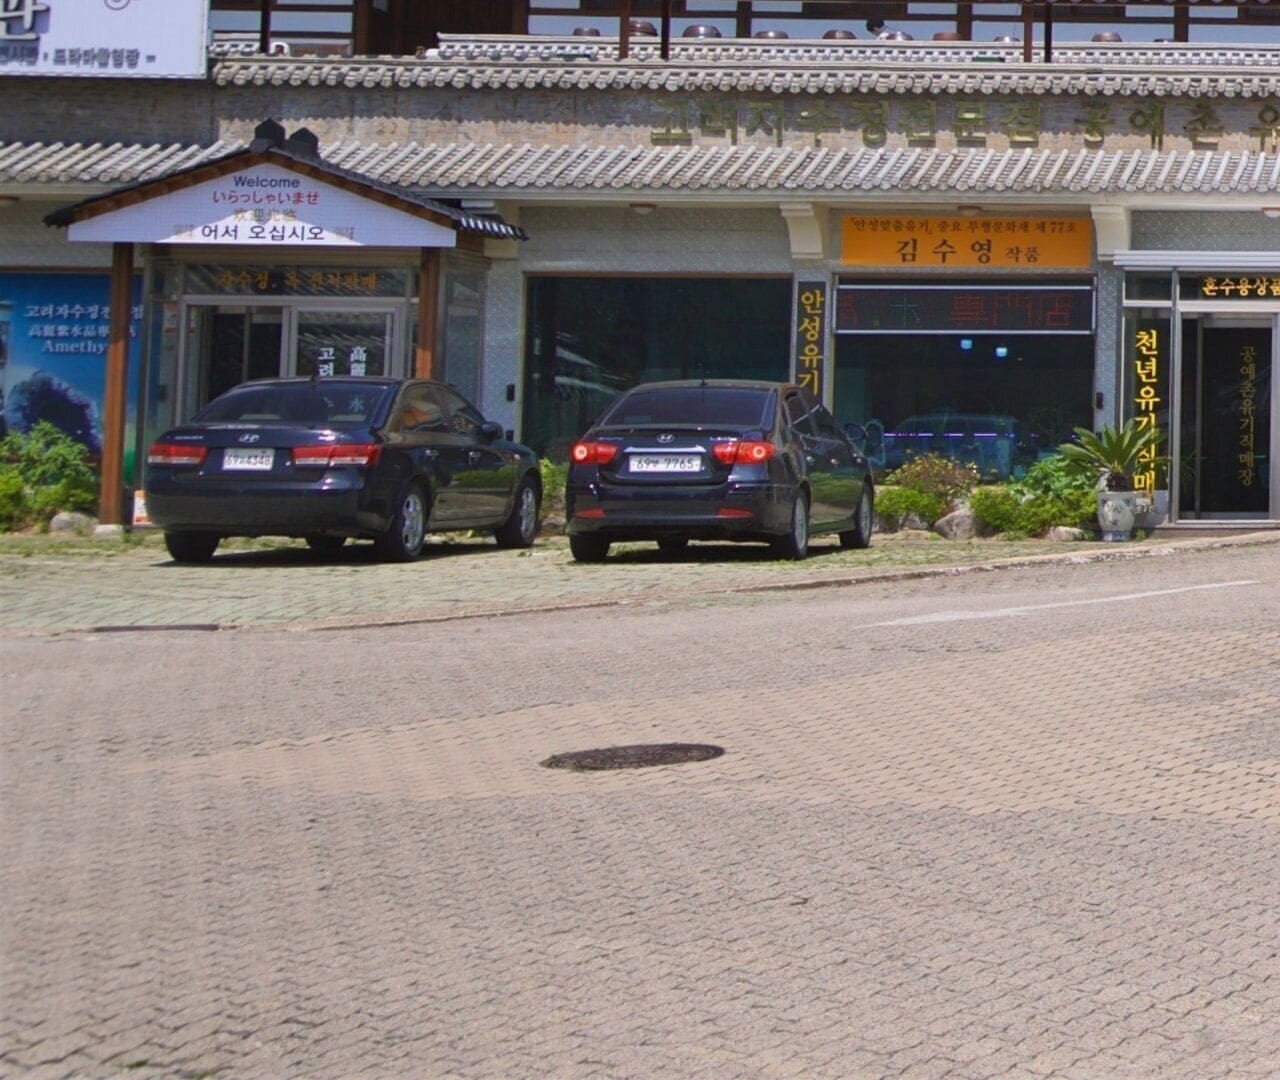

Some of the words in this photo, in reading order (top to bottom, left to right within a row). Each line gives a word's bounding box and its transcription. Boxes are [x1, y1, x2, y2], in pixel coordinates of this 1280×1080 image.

[233, 175, 301, 188] Welcome
[212, 190, 321, 204] いらっしゃいませ
[202, 224, 239, 241] 어서
[248, 224, 325, 242] 오십시오
[1006, 246, 1041, 263] 작품
[42, 340, 107, 355] Amethy
[798, 290, 825, 395] 안성유기
[664, 458, 694, 469] 7765
